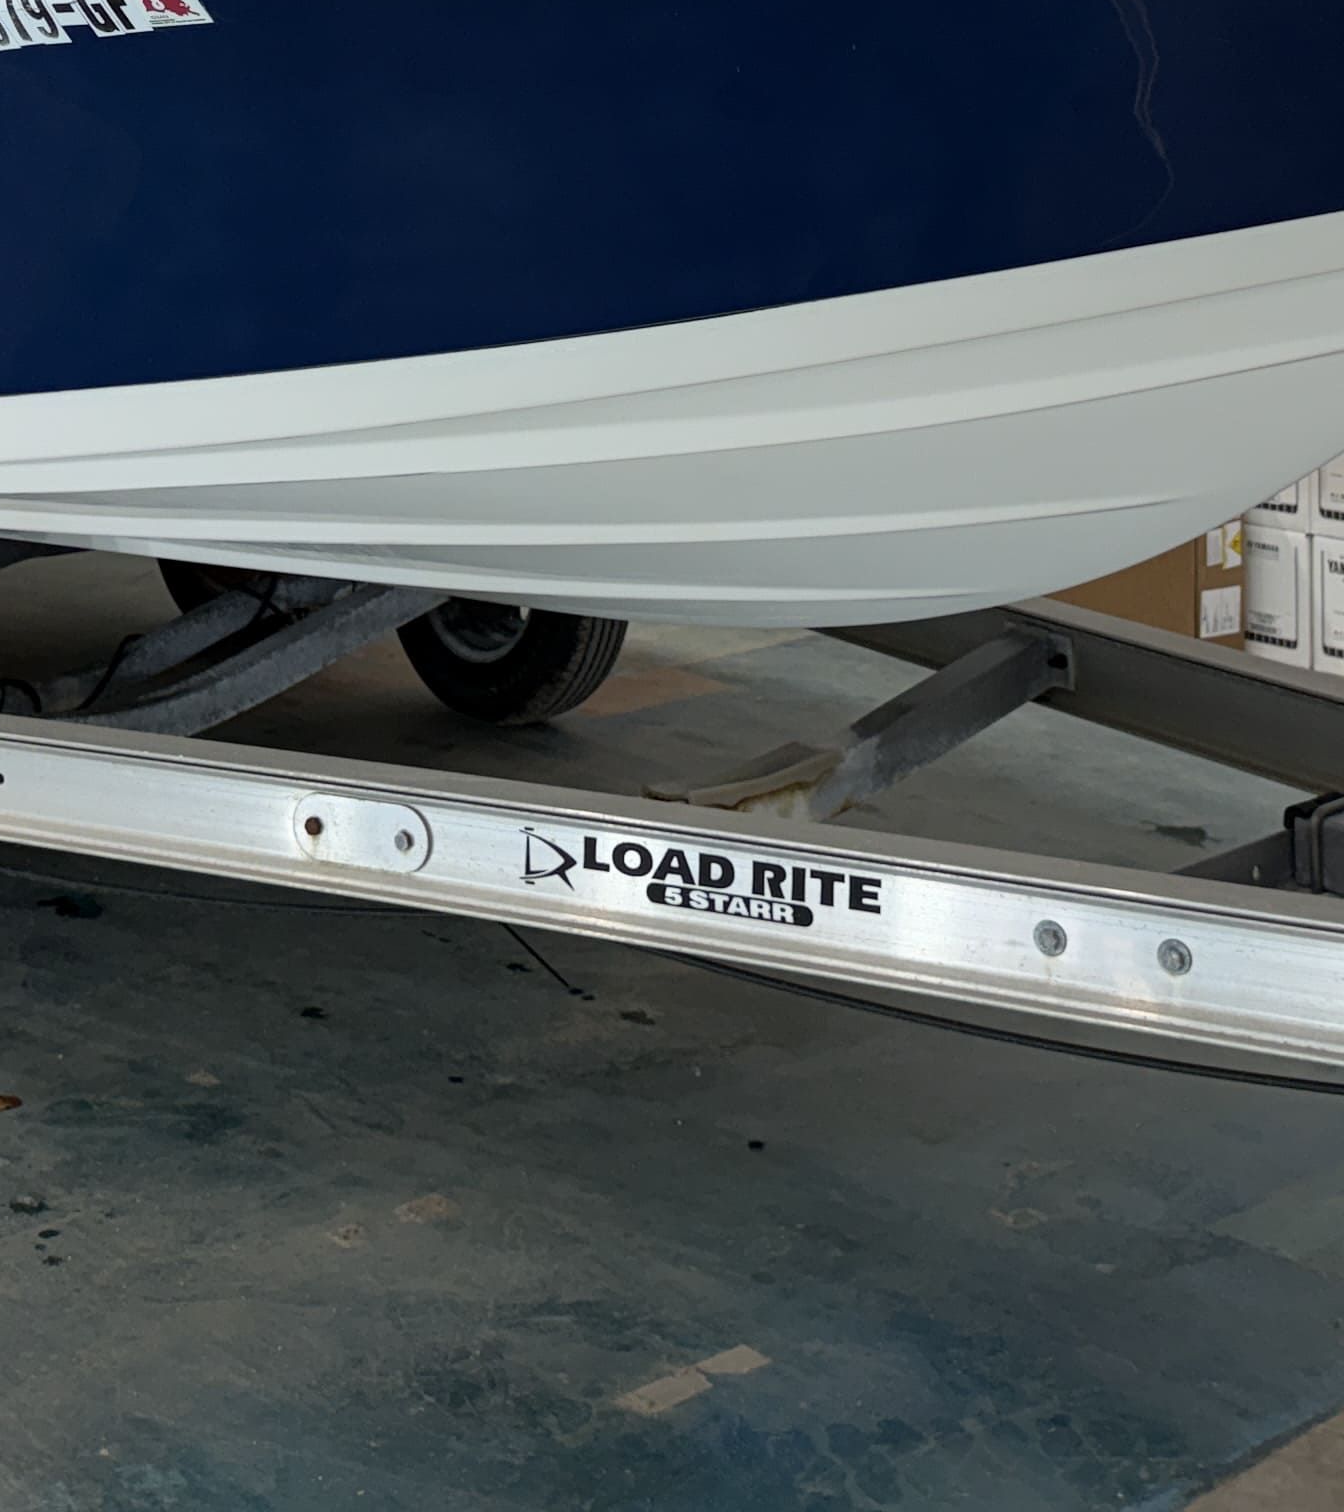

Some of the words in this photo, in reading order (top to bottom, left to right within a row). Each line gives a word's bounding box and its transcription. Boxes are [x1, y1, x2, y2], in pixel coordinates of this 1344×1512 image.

[583, 835, 735, 889] LOAD
[752, 860, 882, 914] RITE
[664, 887, 684, 906] 5
[689, 891, 795, 924] STARR
